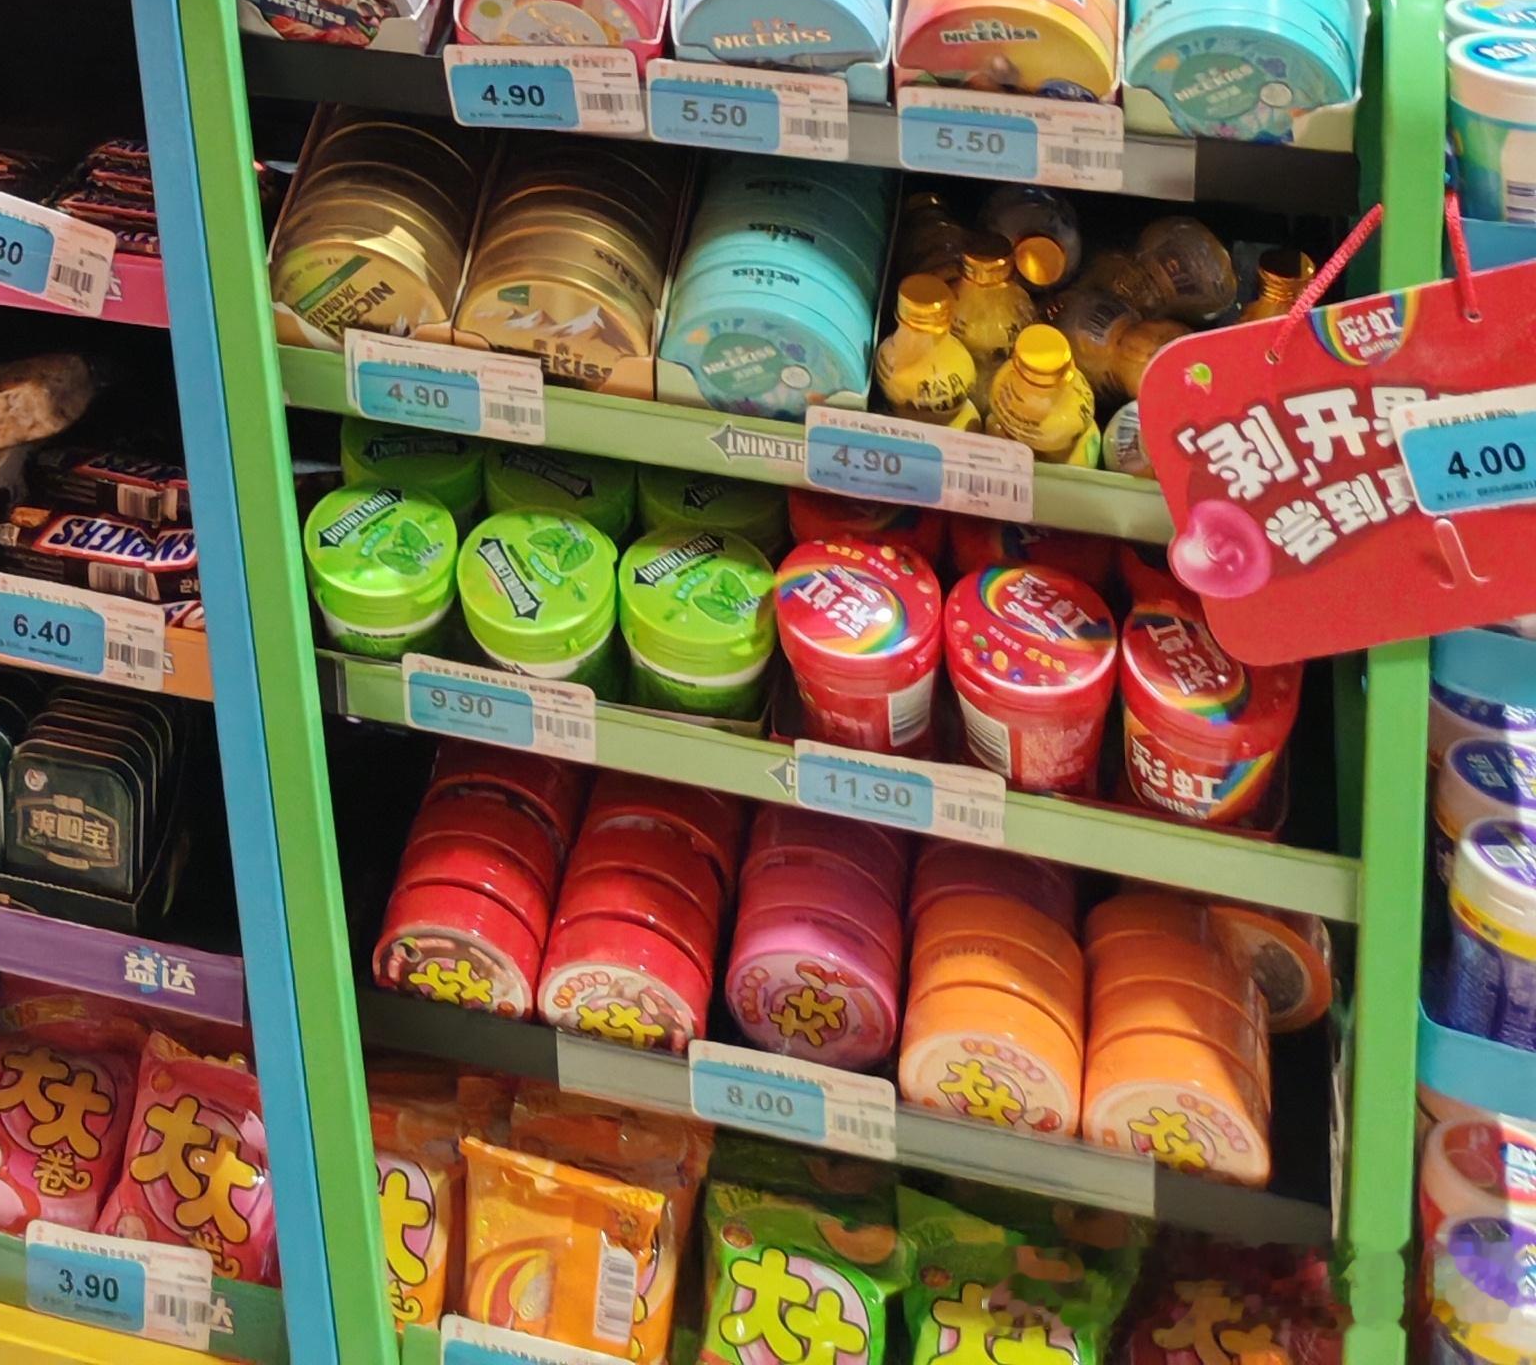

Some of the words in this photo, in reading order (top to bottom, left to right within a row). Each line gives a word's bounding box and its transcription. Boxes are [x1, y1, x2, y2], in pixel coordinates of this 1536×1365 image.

[712, 27, 833, 51] NICEKISS
[941, 26, 1041, 45] NICEKISS
[480, 83, 547, 109] 4.90
[681, 100, 748, 127] 5.50
[936, 127, 1006, 155] 5.50
[386, 381, 451, 411] 4.90
[831, 445, 903, 476] 4.90
[1447, 442, 1527, 481] 4.00
[12, 613, 72, 647] 6.40
[429, 687, 495, 720] 9.90
[822, 771, 913, 808] 11.90
[726, 1084, 795, 1118] 8.00
[57, 1268, 120, 1303] 3.90
